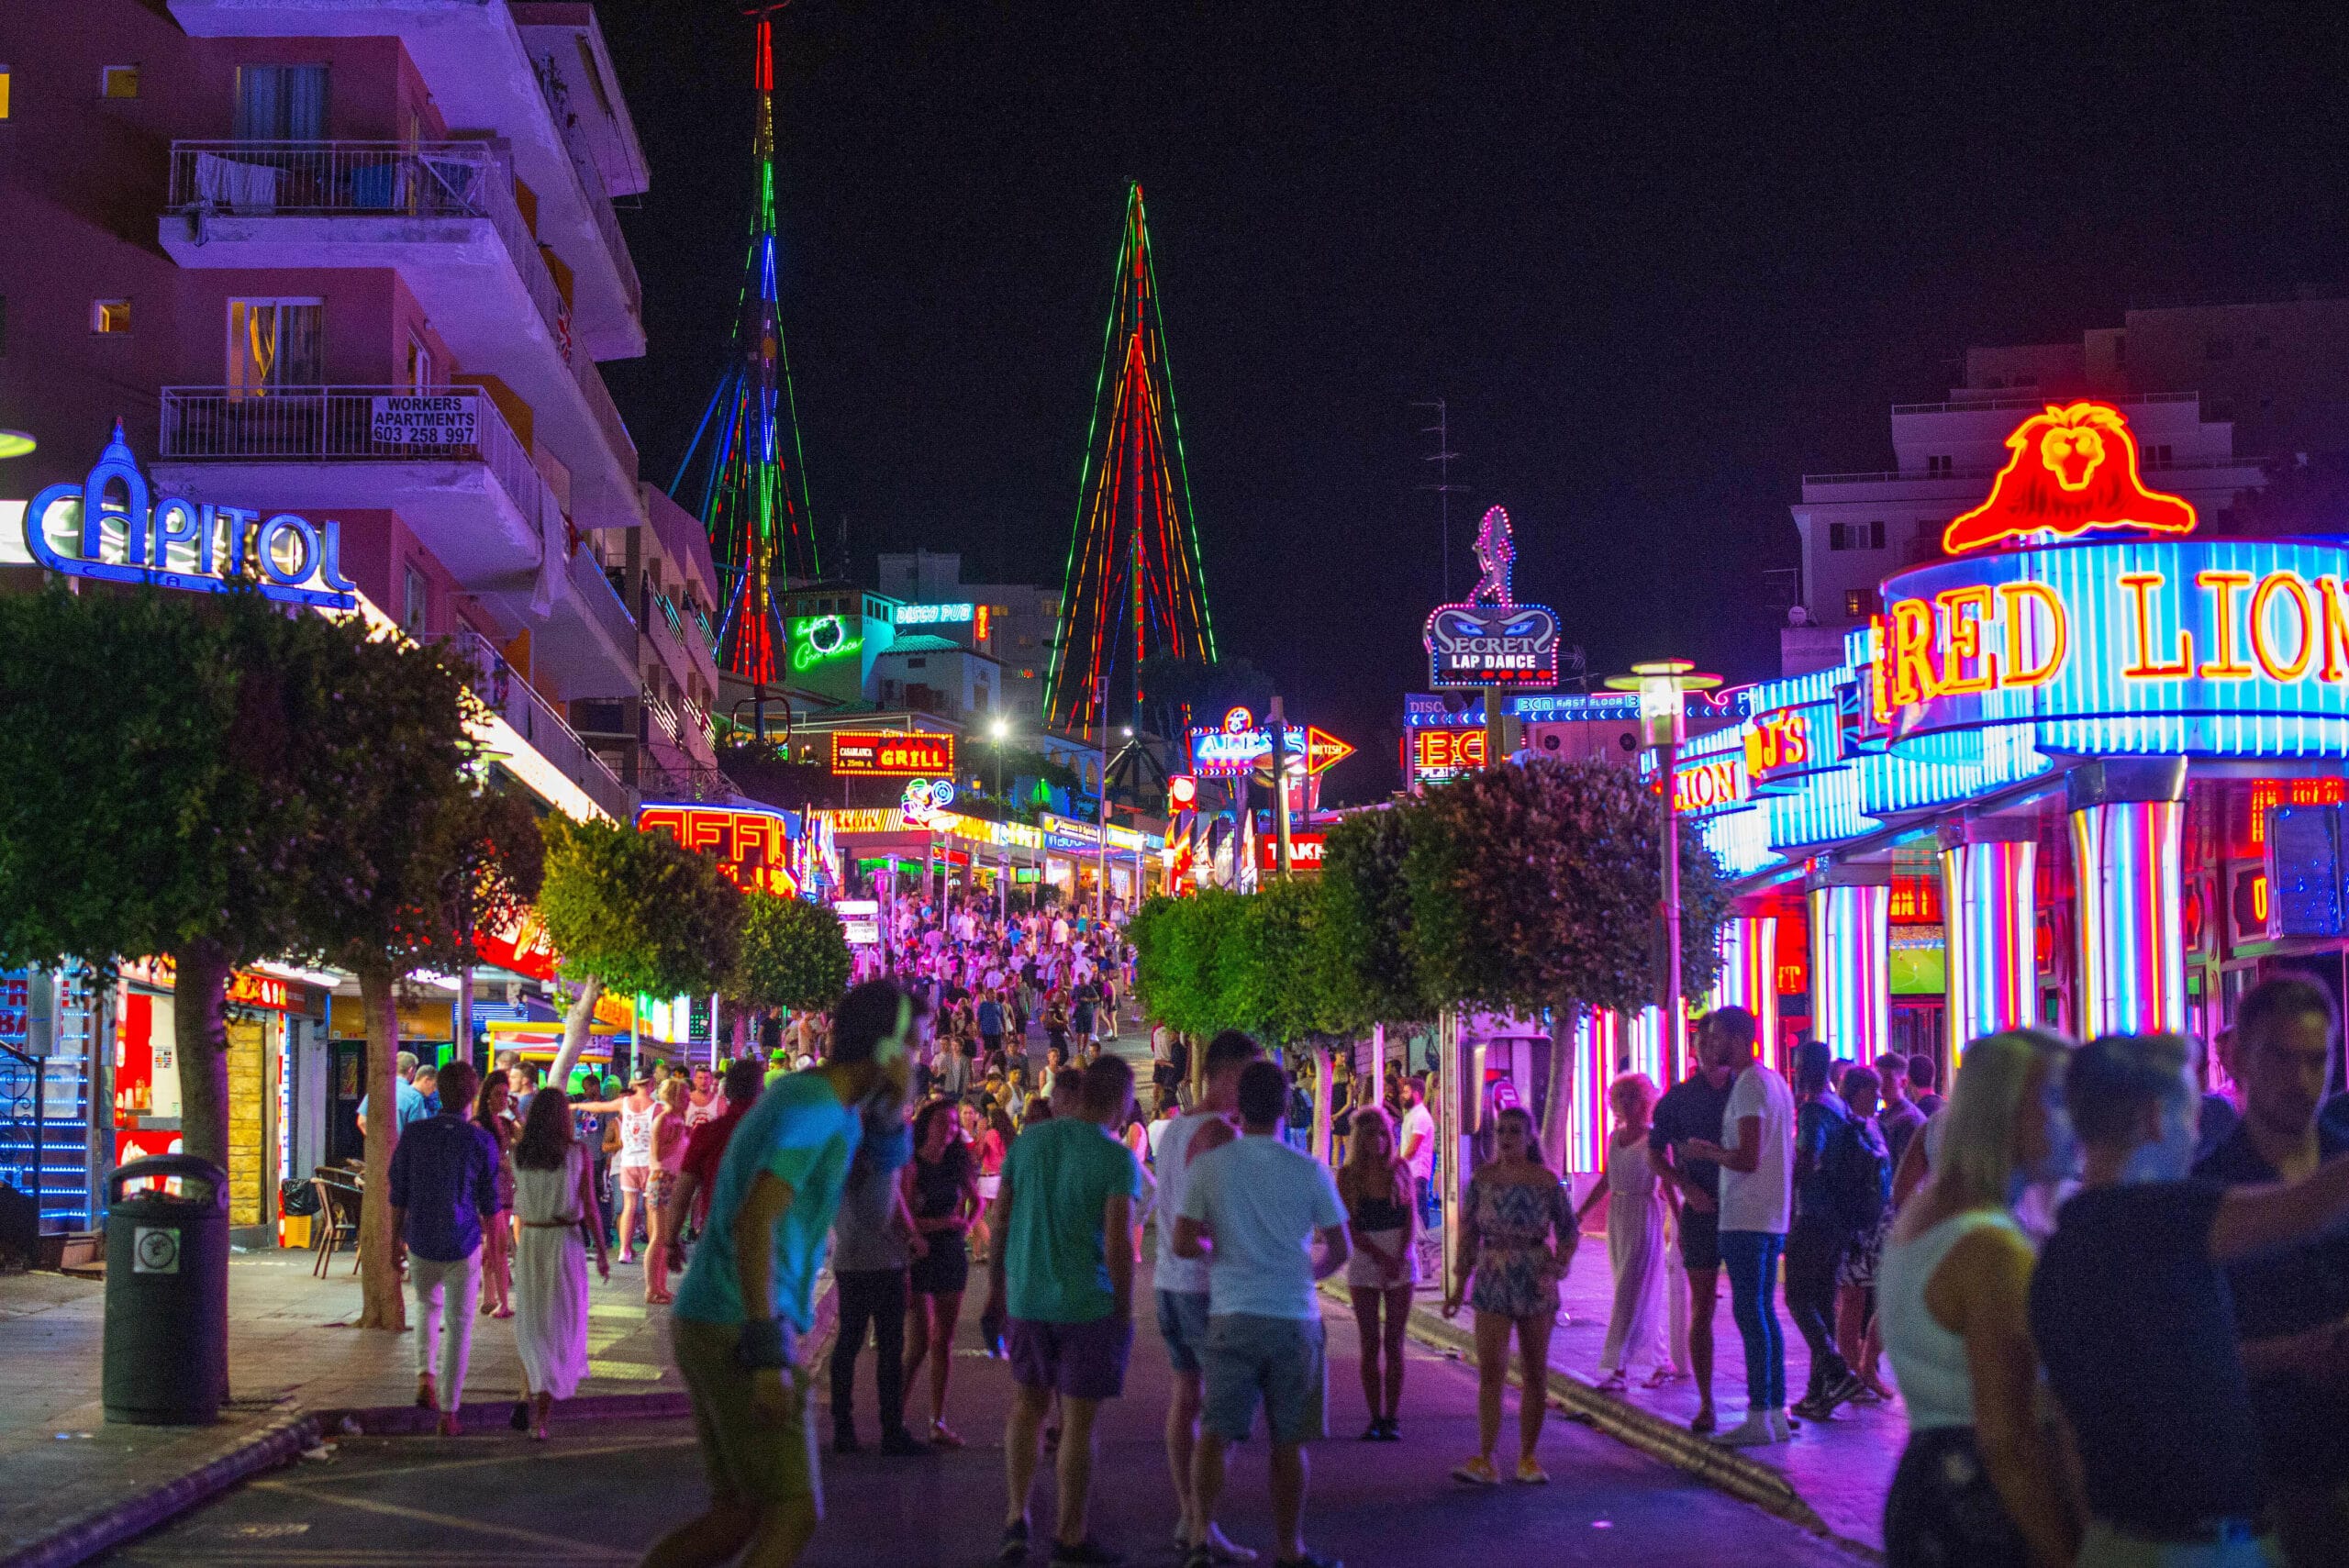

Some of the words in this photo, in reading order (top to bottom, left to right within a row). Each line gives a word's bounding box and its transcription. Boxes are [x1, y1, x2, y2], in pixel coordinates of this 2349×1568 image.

[388, 397, 462, 411] WORKERS
[374, 412, 474, 427] APARTMENTS
[373, 426, 402, 442] 603
[409, 428, 438, 442] 258
[445, 428, 473, 442] 997
[24, 462, 356, 593] CAPITOL
[896, 606, 939, 623] DISCO
[941, 605, 972, 621] PUB
[1891, 580, 2066, 706] RED
[1452, 655, 1480, 668] LAP
[1485, 655, 1536, 668] DANCE
[1517, 697, 1553, 711] BCM
[1556, 699, 1586, 707] FIRST
[1589, 697, 1622, 706] FLOOR
[1310, 744, 1342, 755] BRITISH
[1419, 730, 1488, 767] BC
[840, 748, 873, 757] CASABLANCA
[881, 749, 943, 767] GRILL
[1674, 761, 1736, 812] ION
